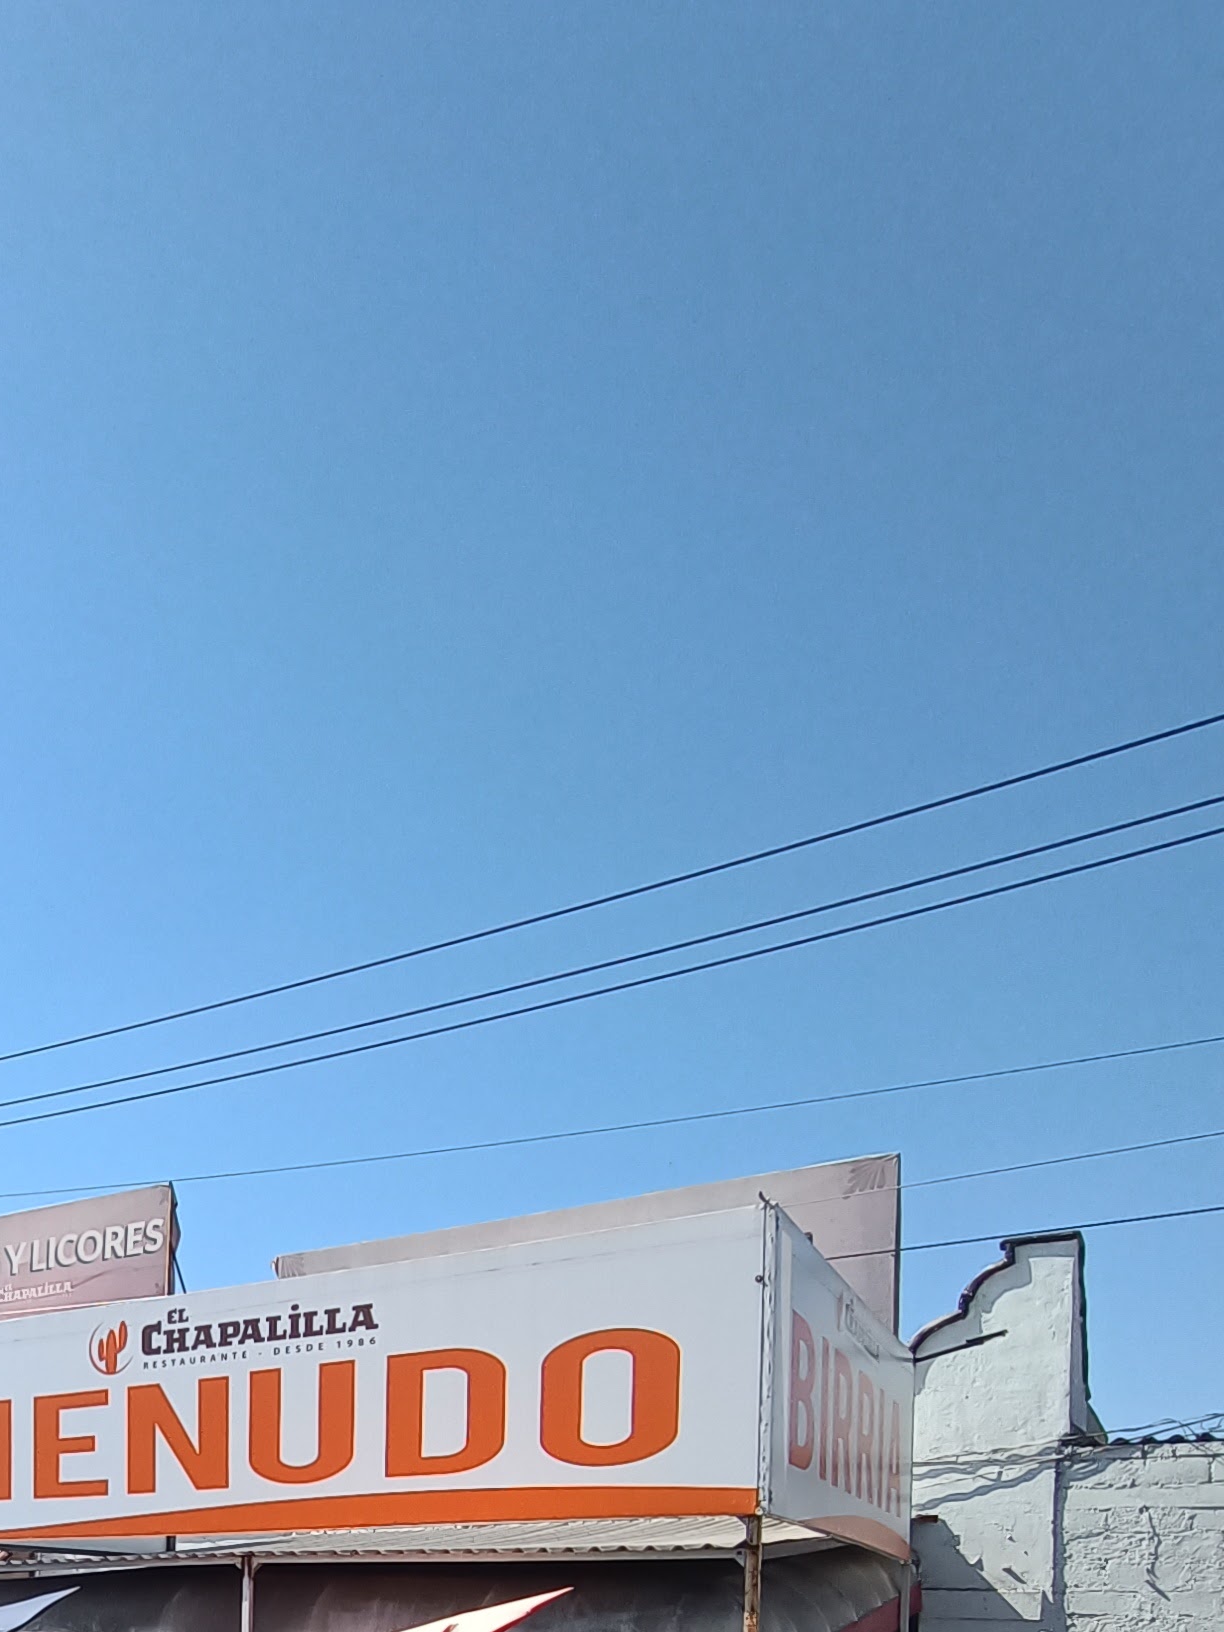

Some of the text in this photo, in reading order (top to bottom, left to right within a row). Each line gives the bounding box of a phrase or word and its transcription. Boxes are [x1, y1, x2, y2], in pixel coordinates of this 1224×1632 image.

[5, 1242, 27, 1276] Y
[29, 1218, 165, 1273] LICORES
[167, 1308, 189, 1325] EL
[143, 1336, 377, 1370] RESTAURANTE DESDE 1986
[788, 1309, 902, 1518] BIRRIA
